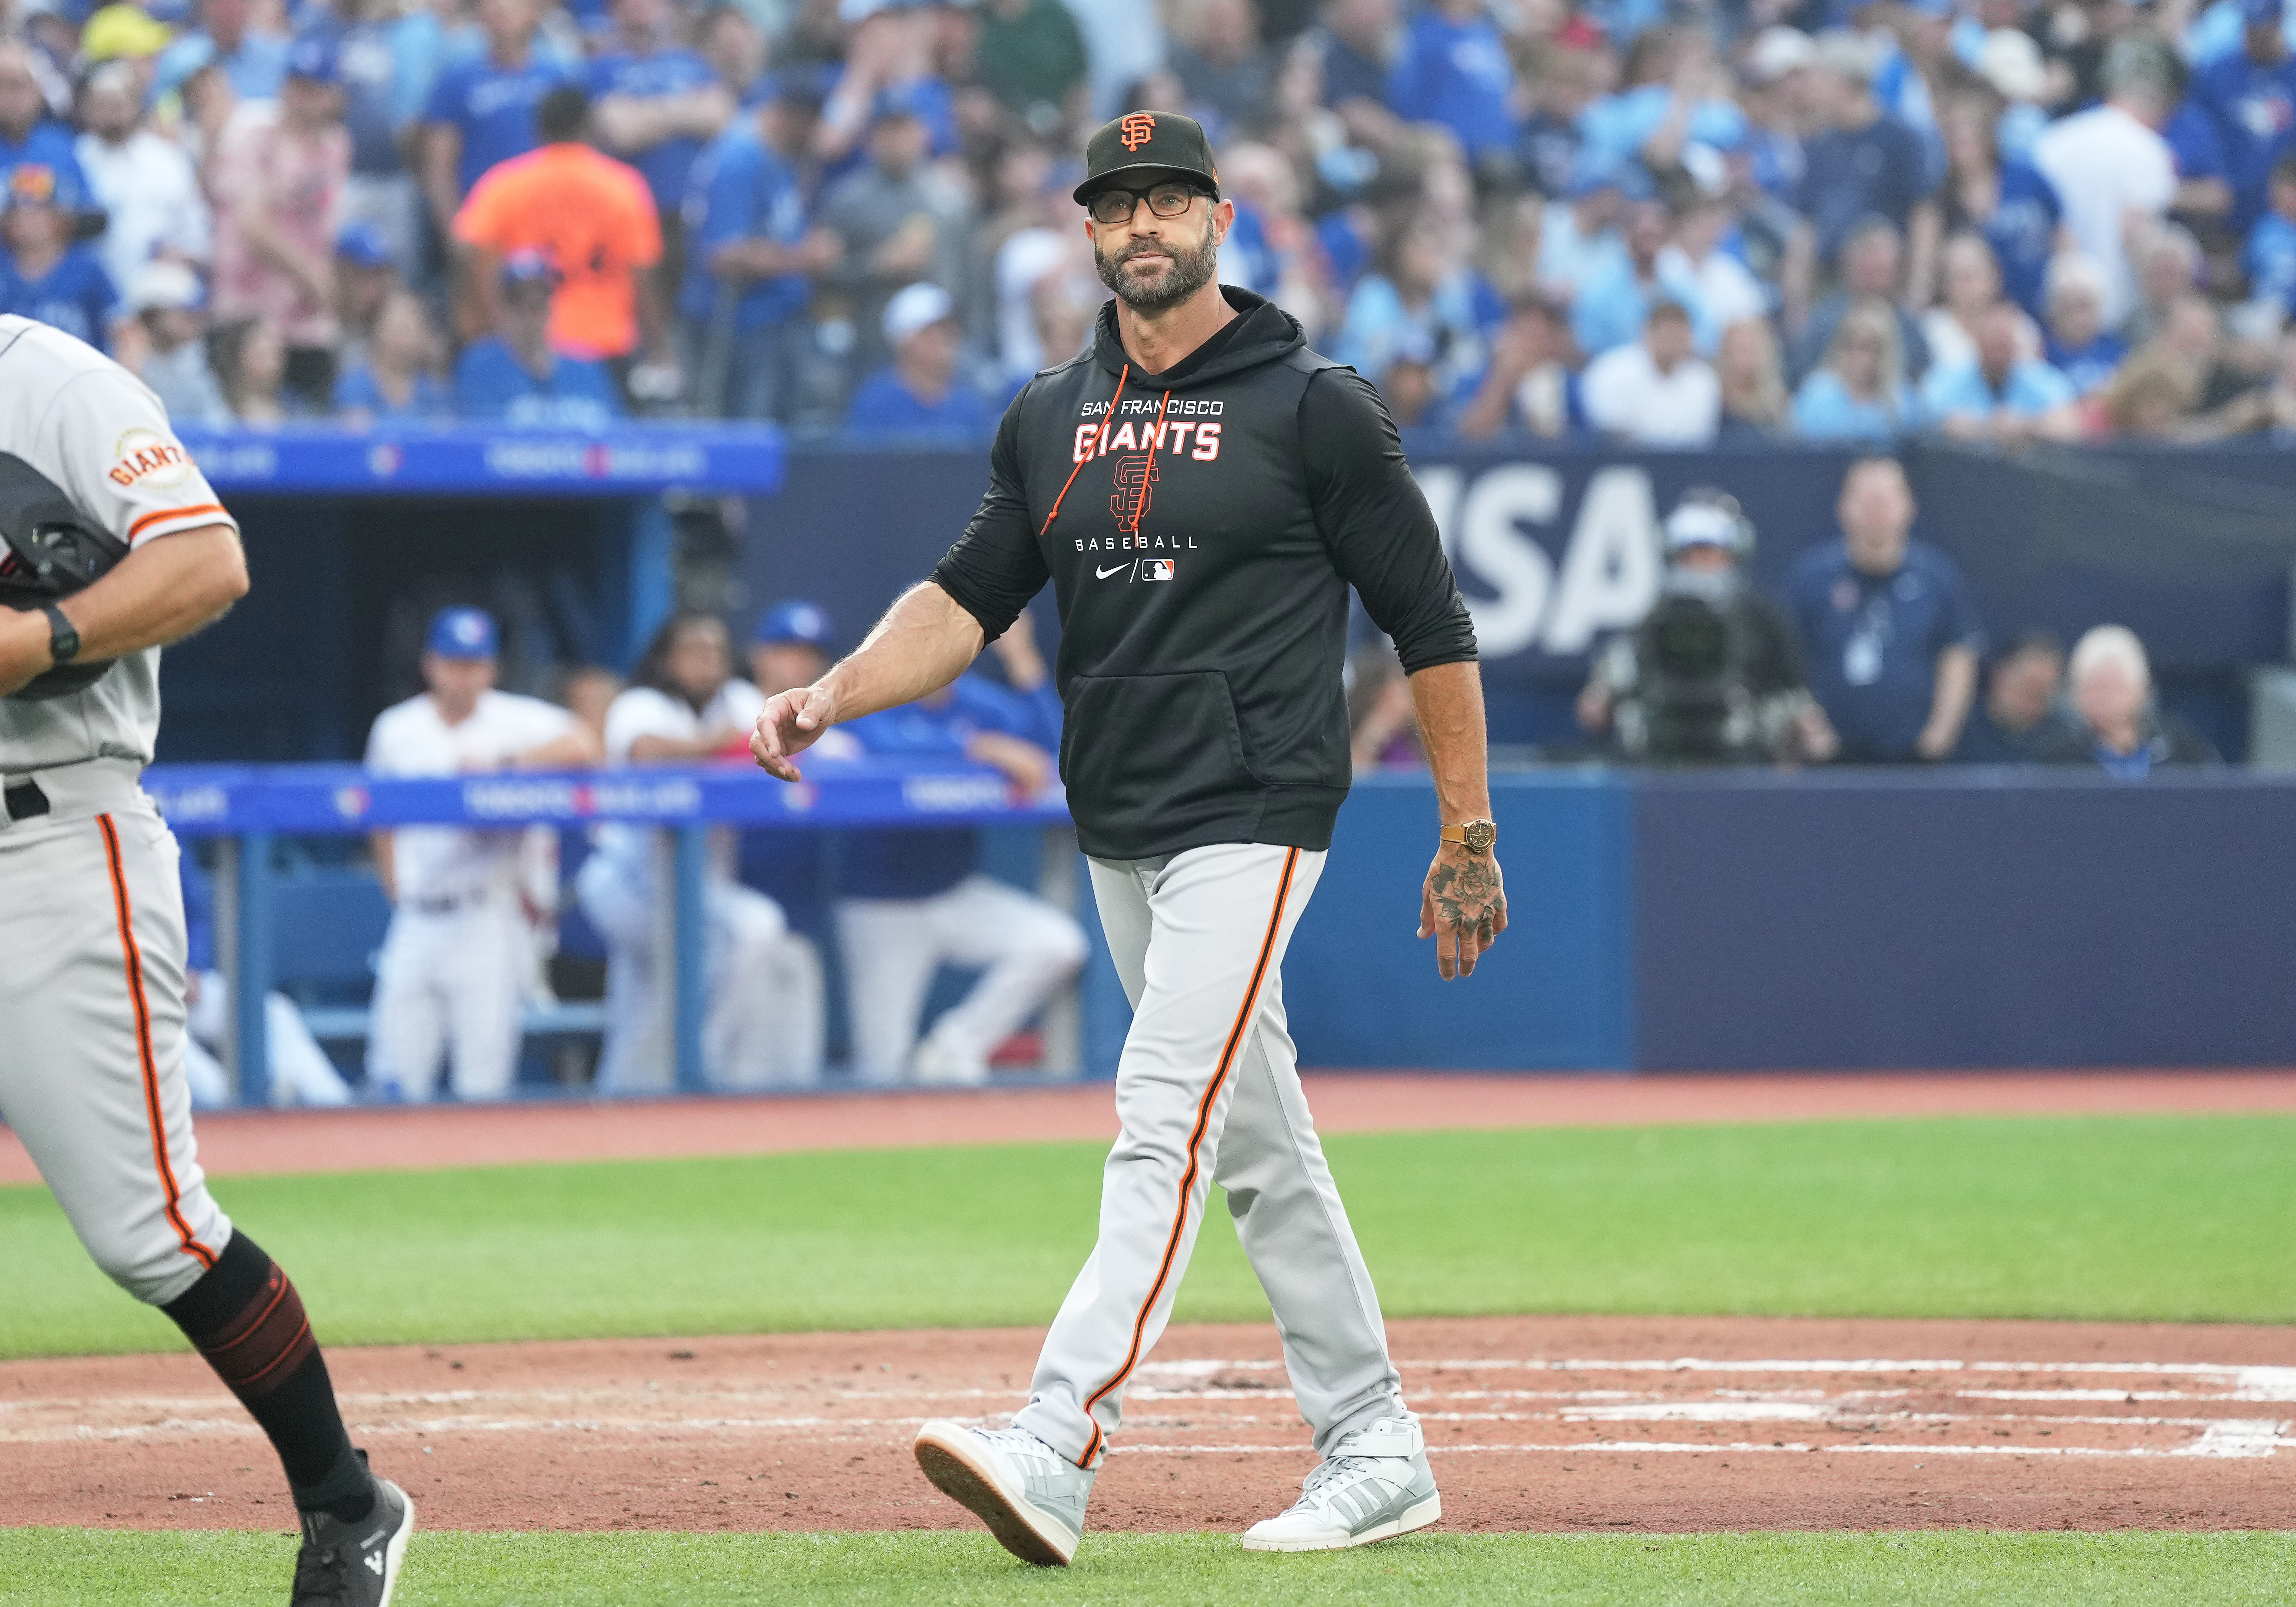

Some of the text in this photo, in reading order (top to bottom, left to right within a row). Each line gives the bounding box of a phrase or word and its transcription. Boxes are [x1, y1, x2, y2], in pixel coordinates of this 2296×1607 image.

[1121, 113, 1156, 153] SF
[1081, 400, 1224, 416] SAN FRANCISCO
[1073, 421, 1222, 463] GIANTS
[109, 444, 198, 487] GIANT
[1075, 536, 1197, 551] BASEBALL
